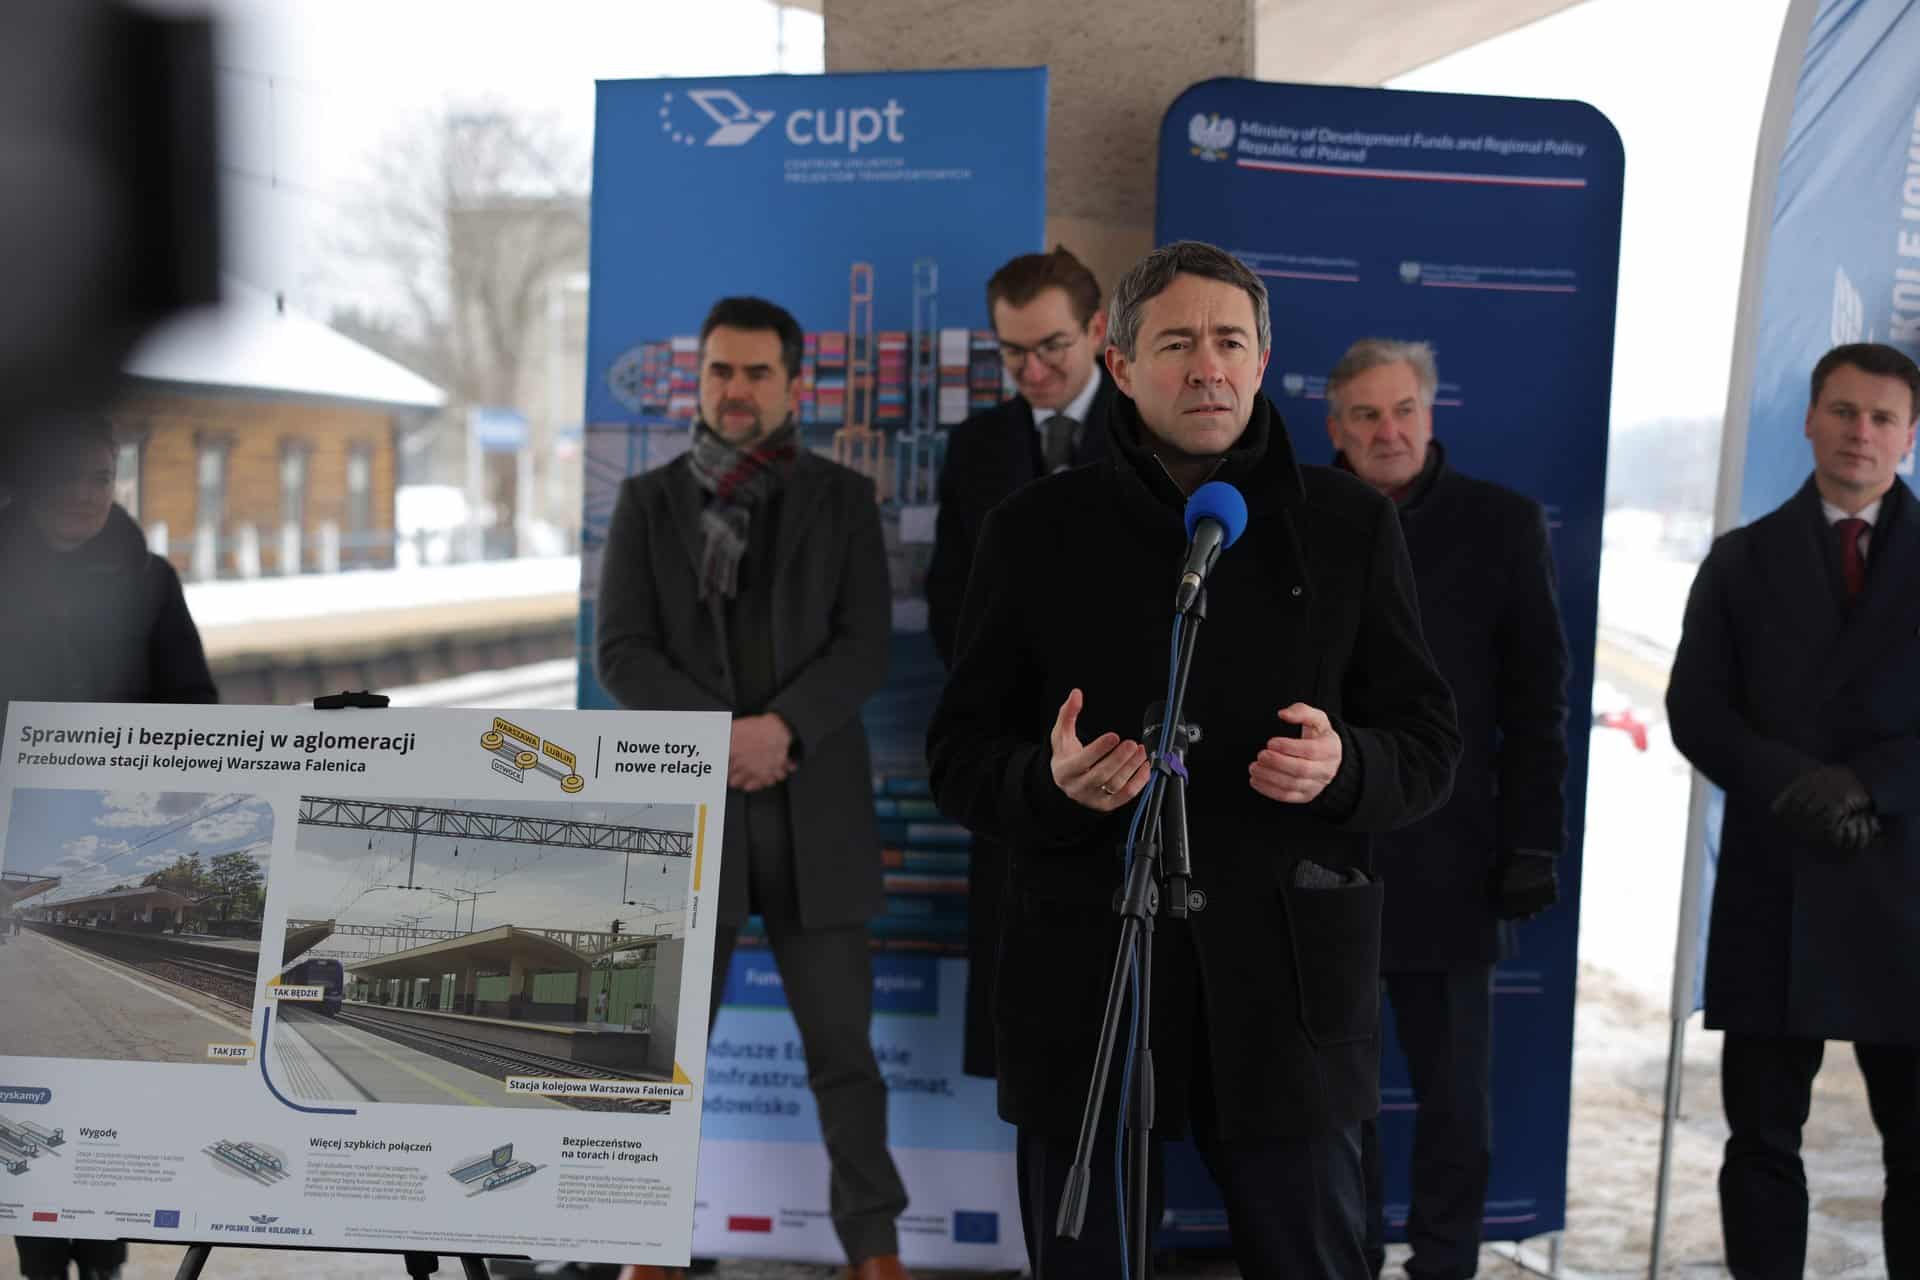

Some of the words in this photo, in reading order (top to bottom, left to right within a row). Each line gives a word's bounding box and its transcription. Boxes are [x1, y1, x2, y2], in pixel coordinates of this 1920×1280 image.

[785, 98, 905, 152] cupt
[1240, 121, 1298, 141] Ministry
[1301, 128, 1317, 141] of
[1318, 128, 1411, 147] Development
[1412, 132, 1453, 149] Funds
[1456, 136, 1482, 150] and
[1483, 136, 1542, 155] Regional
[1544, 139, 1585, 158] Policy
[1237, 138, 1298, 157] Republic
[1301, 144, 1316, 158] of
[1317, 145, 1367, 163] Poland
[20, 726, 122, 748] Sprawniej
[127, 727, 133, 744] i
[139, 728, 265, 750] bezpieczniej
[271, 734, 287, 748] w
[293, 730, 416, 755] aglomeracji
[496, 719, 538, 746] WARSZAWA
[546, 745, 573, 764] LUBLIN
[617, 741, 660, 754] Nowe
[663, 743, 700, 756] tory,
[17, 752, 106, 767] Przebudowa
[110, 754, 149, 769] stacji
[152, 755, 223, 771] kolejowej
[227, 757, 301, 772] Warszawa
[305, 759, 366, 773] Falenica
[615, 762, 656, 774] nowe
[661, 762, 712, 777] relacje
[494, 763, 521, 779] OTWOCK
[273, 988, 288, 997] TAK
[289, 989, 320, 999] BĘDZIE
[213, 1047, 228, 1056] TAK
[229, 1048, 247, 1057] JEST
[509, 1080, 539, 1092] Stacja
[542, 1081, 587, 1094] kolejowa
[589, 1083, 640, 1095] Warszawa
[643, 1085, 684, 1096] Falenica
[79, 1127, 117, 1140] Wygodę
[310, 1137, 342, 1150] Więcej
[344, 1138, 386, 1151] szybkich
[388, 1141, 432, 1154] połączeń
[562, 1137, 642, 1150] Bezpieczeństwo
[561, 1150, 573, 1159] na
[575, 1149, 609, 1160] torach
[617, 1151, 658, 1163] drogach
[225, 1224, 250, 1232] POLSKIE
[252, 1225, 267, 1233] LINIE
[268, 1227, 300, 1235] KOLEJOWE
